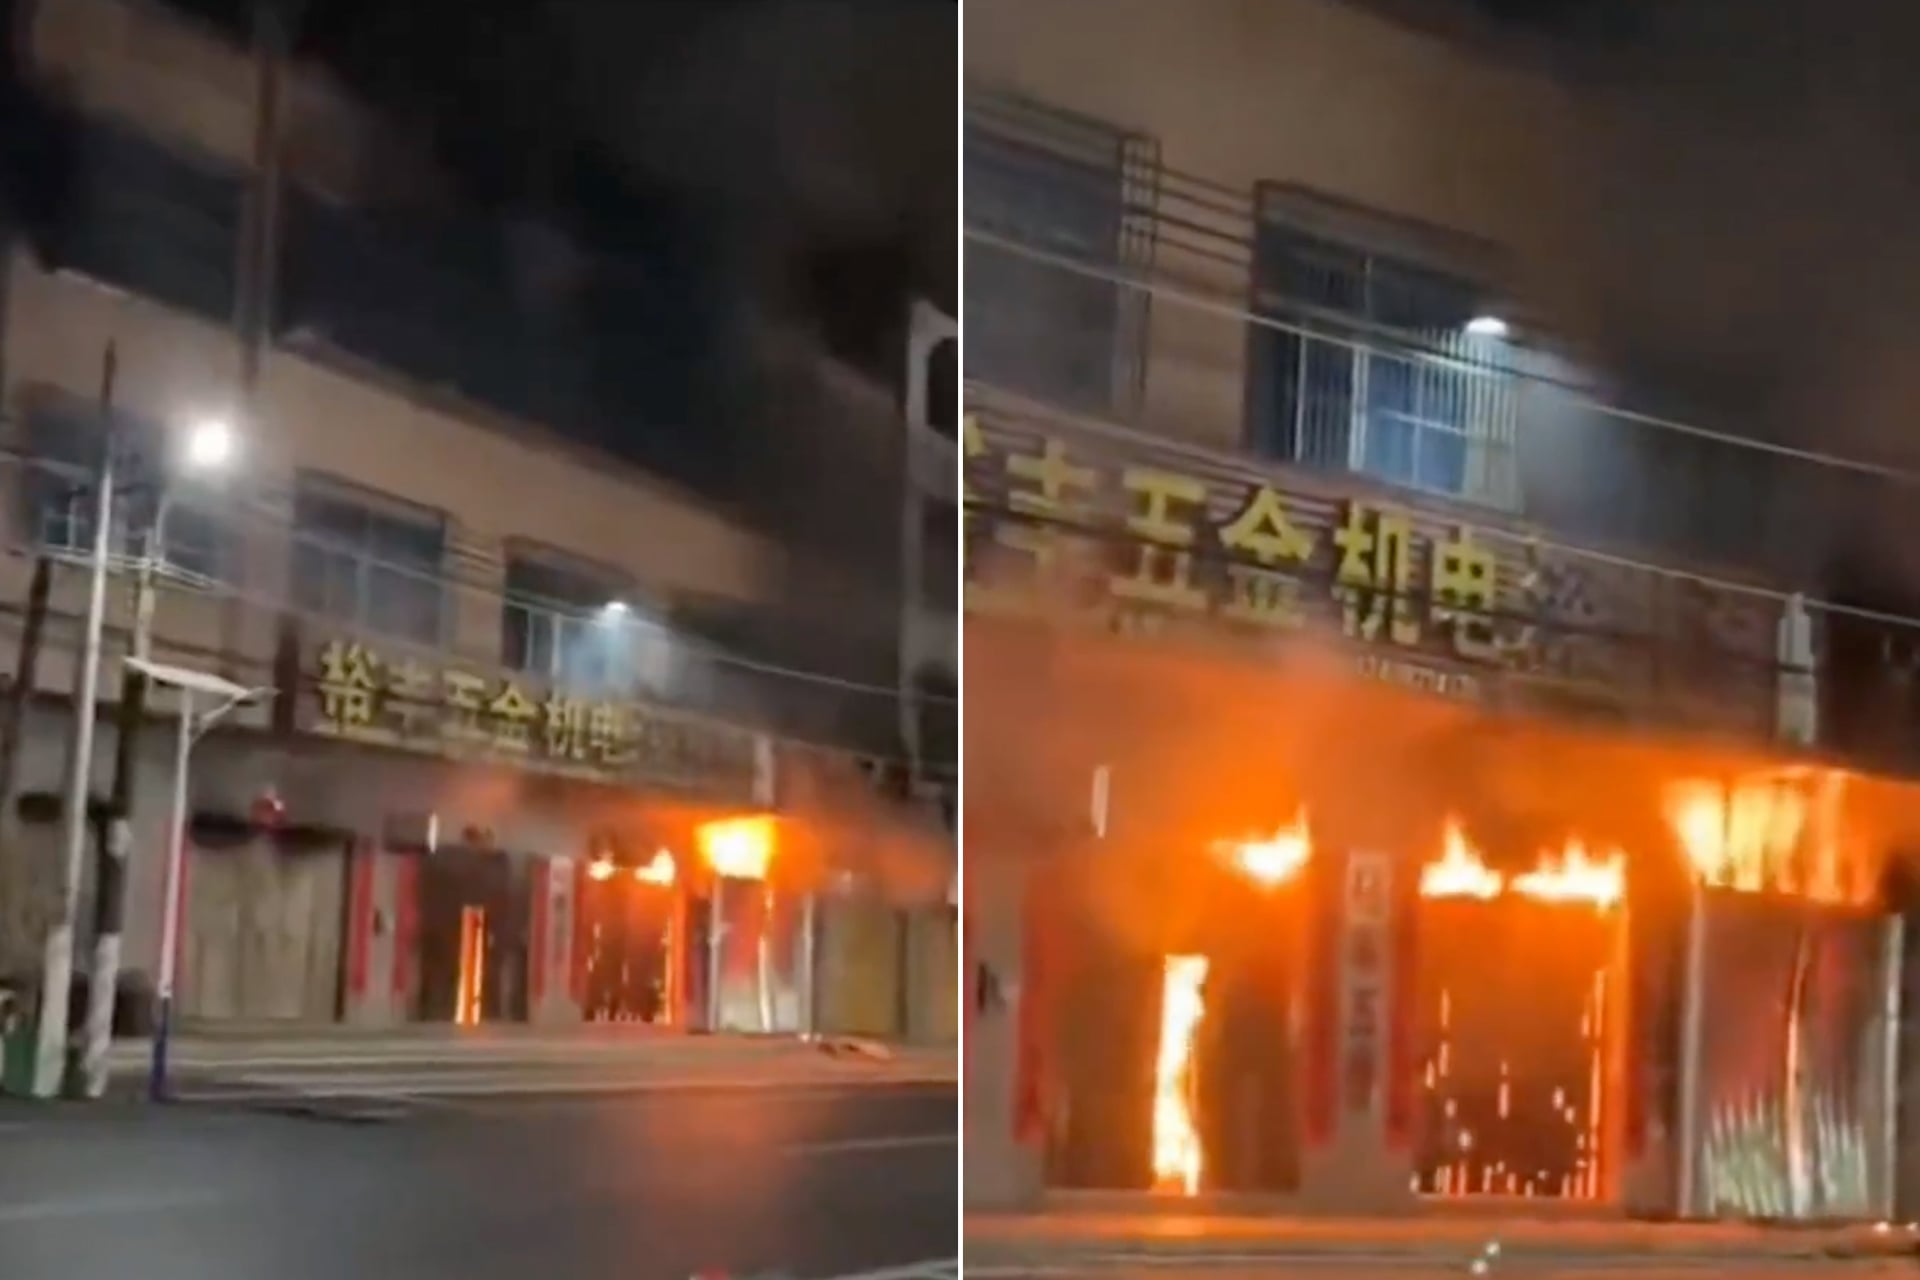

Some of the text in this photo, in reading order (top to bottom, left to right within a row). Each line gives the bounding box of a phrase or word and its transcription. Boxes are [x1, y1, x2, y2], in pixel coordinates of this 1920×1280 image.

[963, 414, 1540, 658] 丰五金机电
